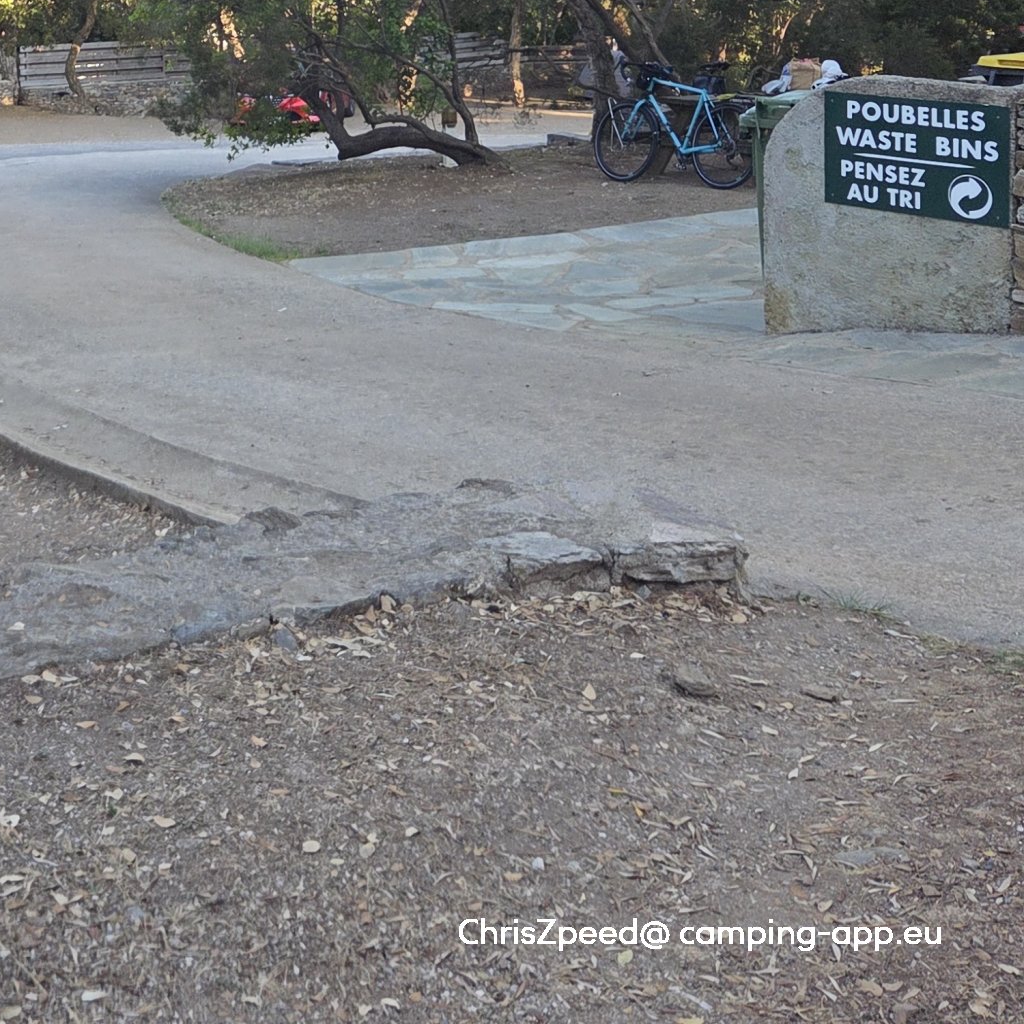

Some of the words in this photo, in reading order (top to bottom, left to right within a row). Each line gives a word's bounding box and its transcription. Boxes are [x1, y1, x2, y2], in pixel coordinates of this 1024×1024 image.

[846, 99, 986, 132] POUBELLES
[835, 125, 917, 154] WASTE
[935, 136, 999, 162] BINS
[840, 159, 926, 188] PENSEZ
[846, 183, 879, 204] AU
[886, 187, 921, 210] TRI
